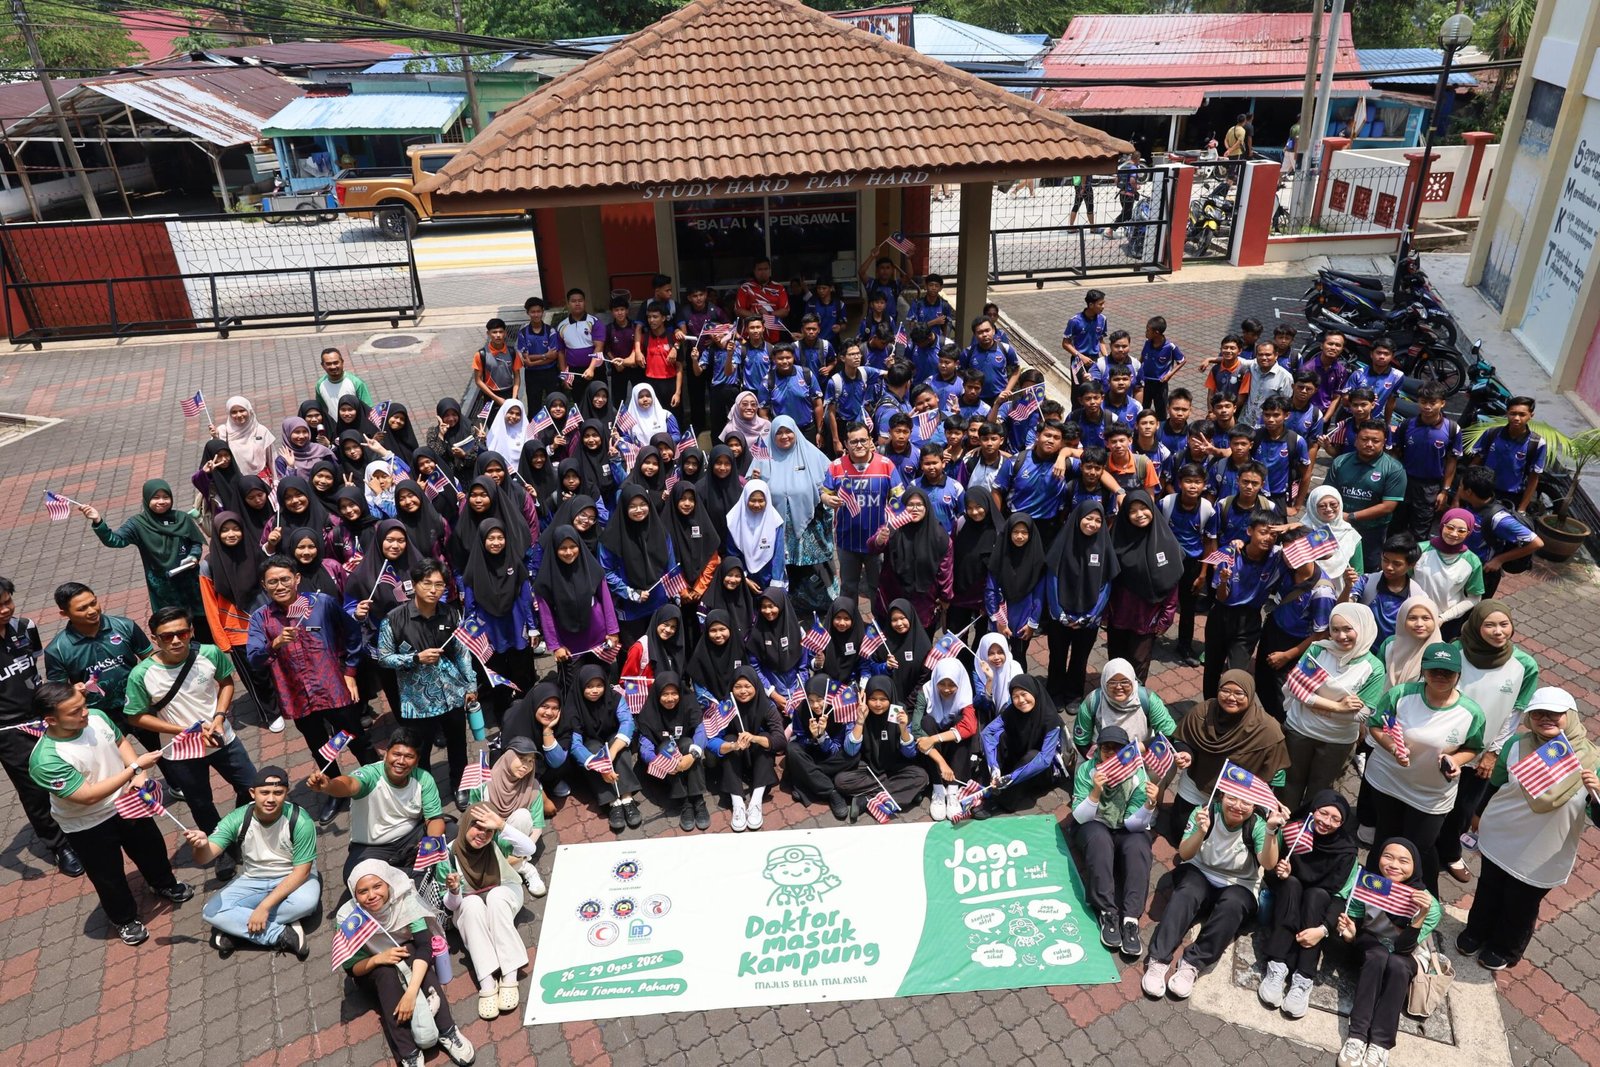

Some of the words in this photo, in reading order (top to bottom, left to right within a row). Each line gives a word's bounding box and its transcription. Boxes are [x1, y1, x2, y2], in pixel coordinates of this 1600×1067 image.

[724, 178, 790, 195] HARD
[804, 173, 857, 190] PLAY
[696, 217, 747, 231] BALAI
[769, 212, 850, 227] PENGAWAL
[854, 479, 869, 490] 77
[1341, 486, 1373, 498] TekSeS
[944, 838, 1028, 869] Jaga
[953, 860, 1017, 895] Diri
[745, 906, 840, 939] Doktor
[762, 918, 856, 955] masuk
[560, 970, 575, 982] 26
[588, 965, 604, 978] 29
[606, 962, 634, 975] Ogos
[636, 954, 664, 968] 2026
[737, 942, 880, 978] Kampung
[554, 986, 588, 998] Pulau
[637, 982, 681, 993] Pahang
[754, 980, 790, 990] MAJLIS
[792, 979, 818, 988] BELIA
[821, 975, 868, 986] MALAYSIA
